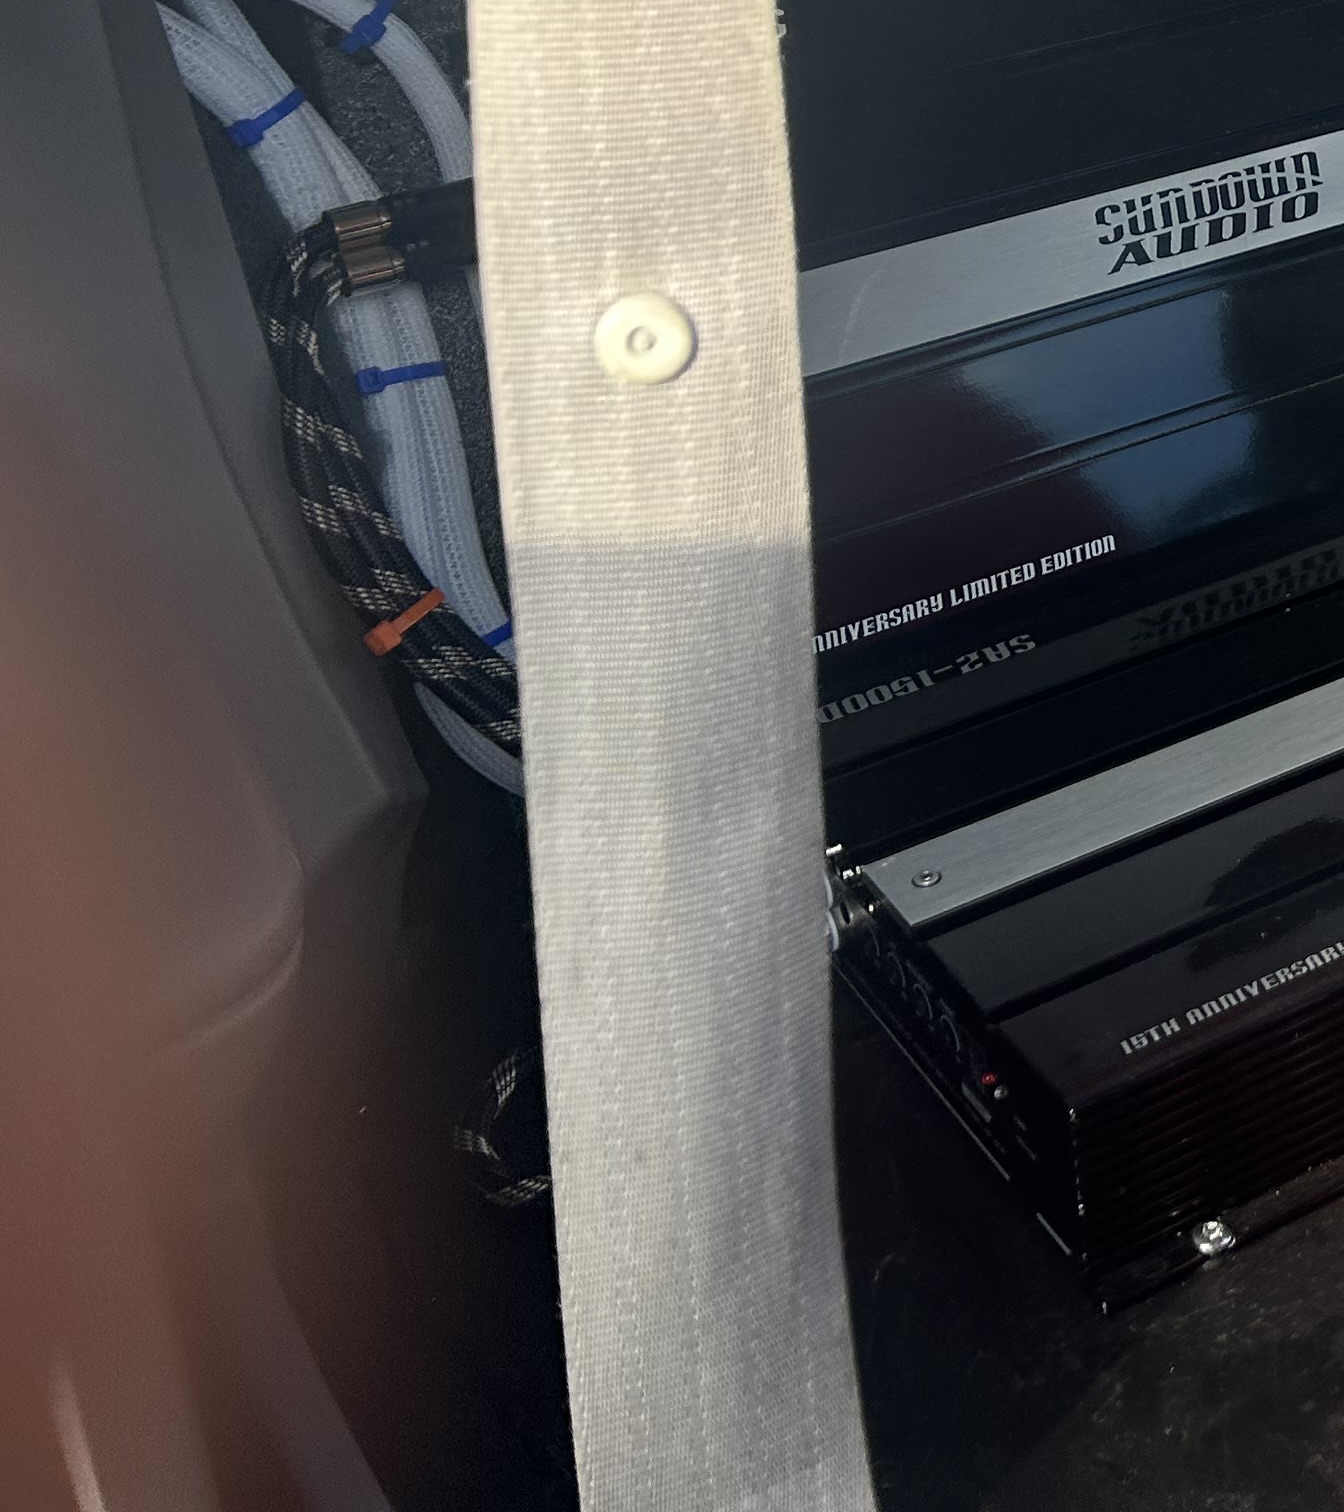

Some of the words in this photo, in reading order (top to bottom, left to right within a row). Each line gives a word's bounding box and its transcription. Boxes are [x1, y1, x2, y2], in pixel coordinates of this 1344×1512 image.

[1094, 151, 1324, 245] SUNDOWN
[1107, 190, 1320, 276] AUDIO
[811, 592, 944, 655] NNIVERSARY
[949, 561, 1037, 608] LIMITED
[1040, 534, 1117, 576] EDITION
[1119, 1018, 1180, 1055] 15TH
